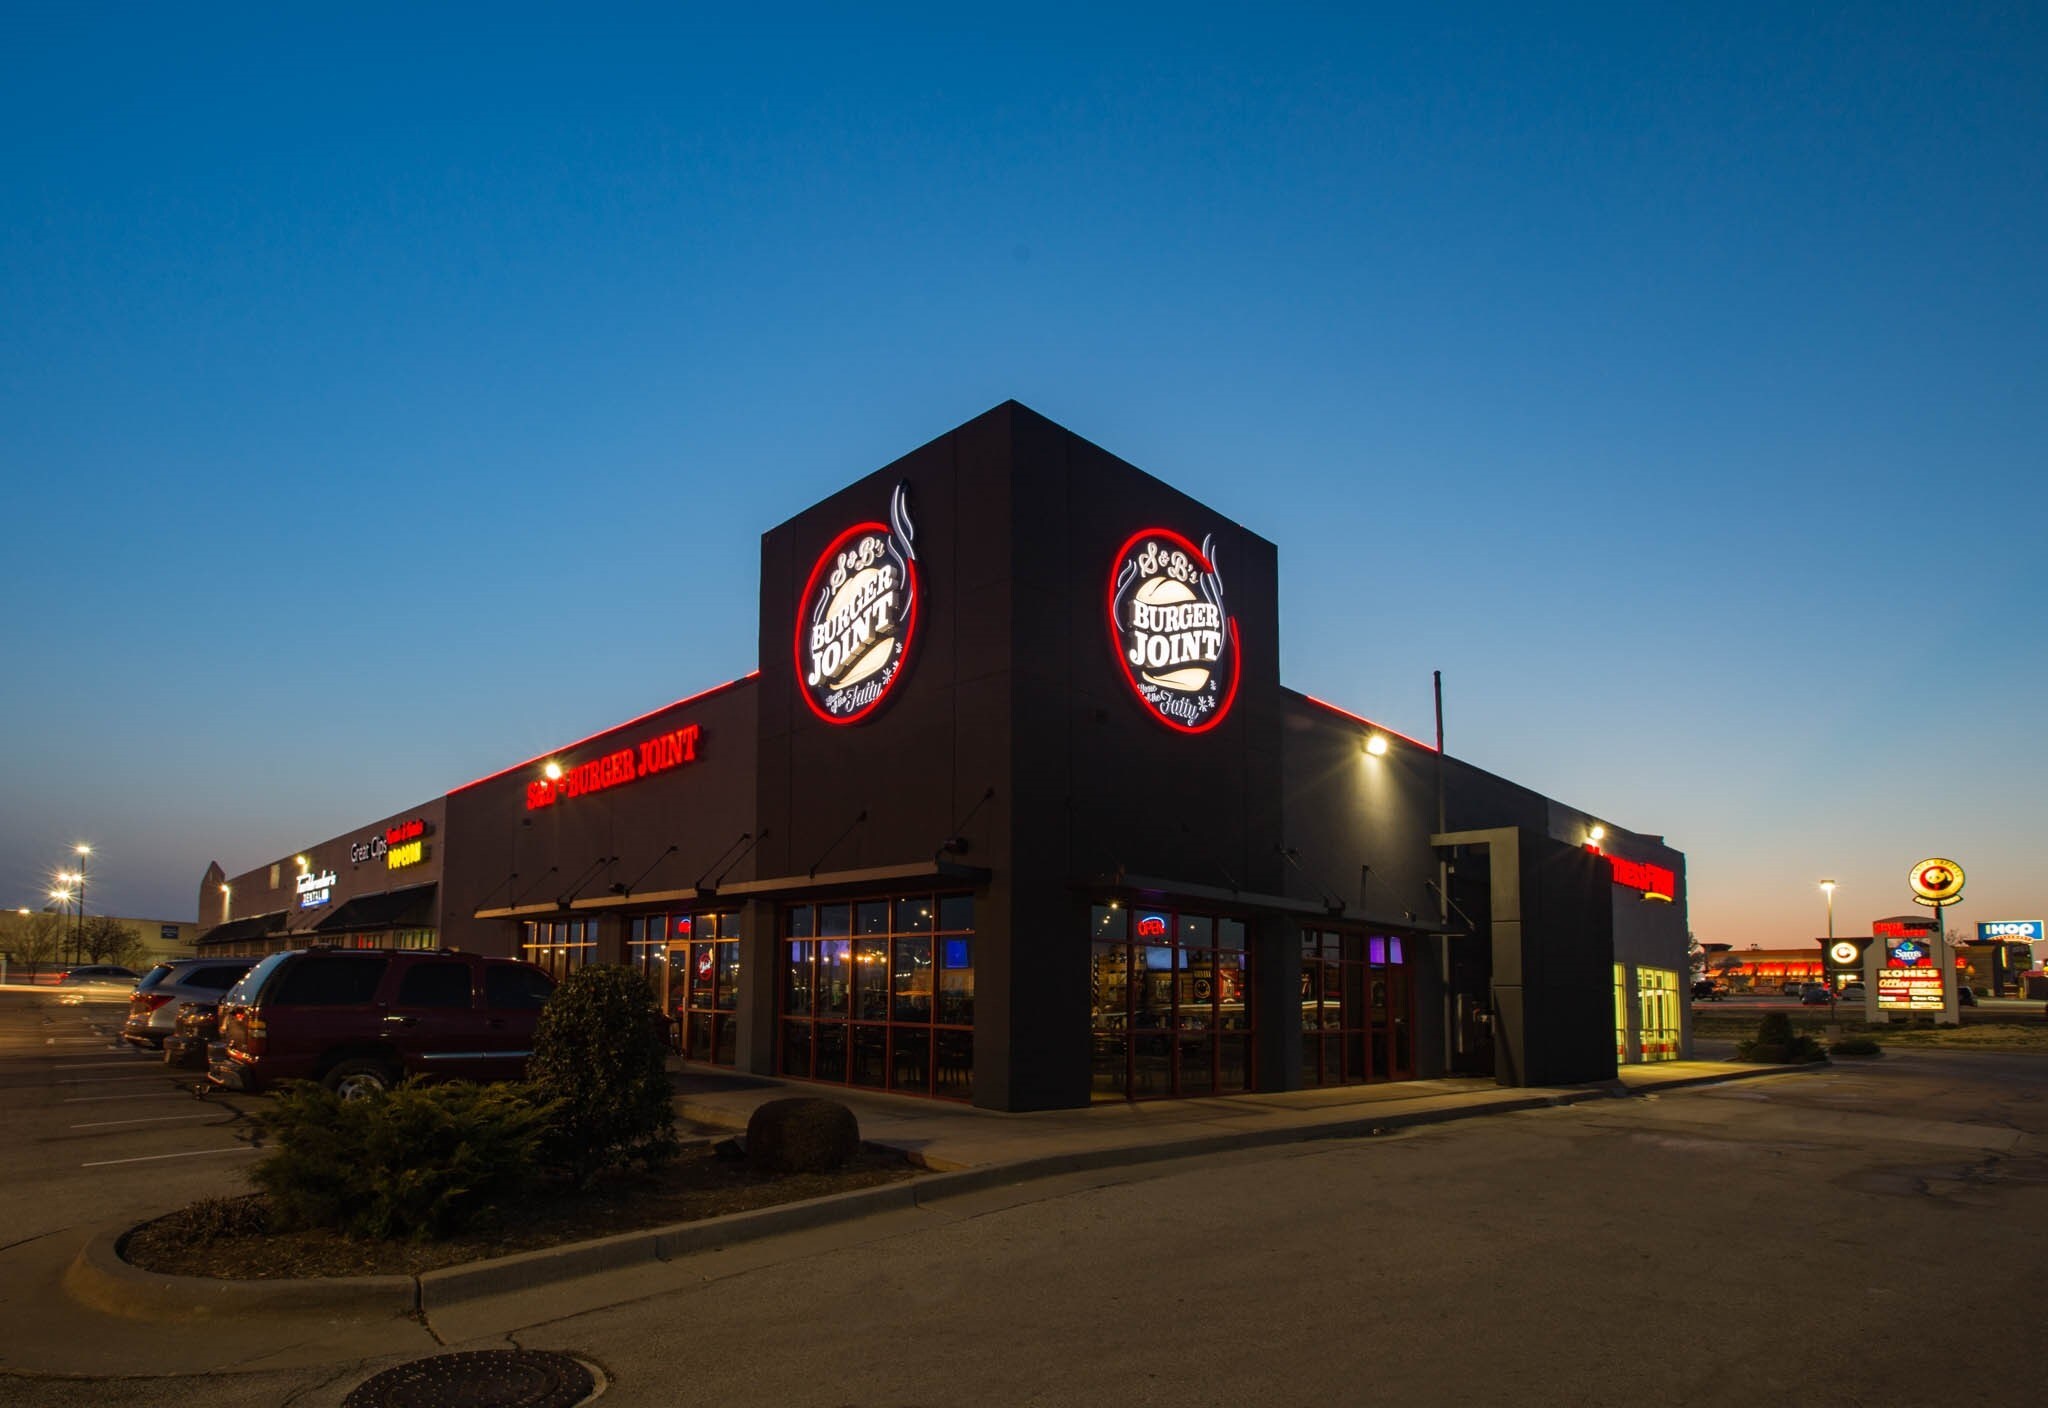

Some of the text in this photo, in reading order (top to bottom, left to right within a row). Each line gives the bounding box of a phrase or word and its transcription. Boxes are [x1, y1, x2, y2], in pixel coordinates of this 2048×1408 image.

[1138, 541, 1199, 584] S&B's
[812, 564, 894, 651] BURGER
[1133, 600, 1220, 633] BURGER
[808, 590, 895, 686] JOINT
[1129, 630, 1221, 668] JOINT
[567, 748, 636, 798] BURGER
[638, 724, 698, 777] JOINT
[1137, 919, 1167, 936] OPEN
[1879, 969, 1938, 978] KOHL'S
[1879, 979, 1911, 988] Office
